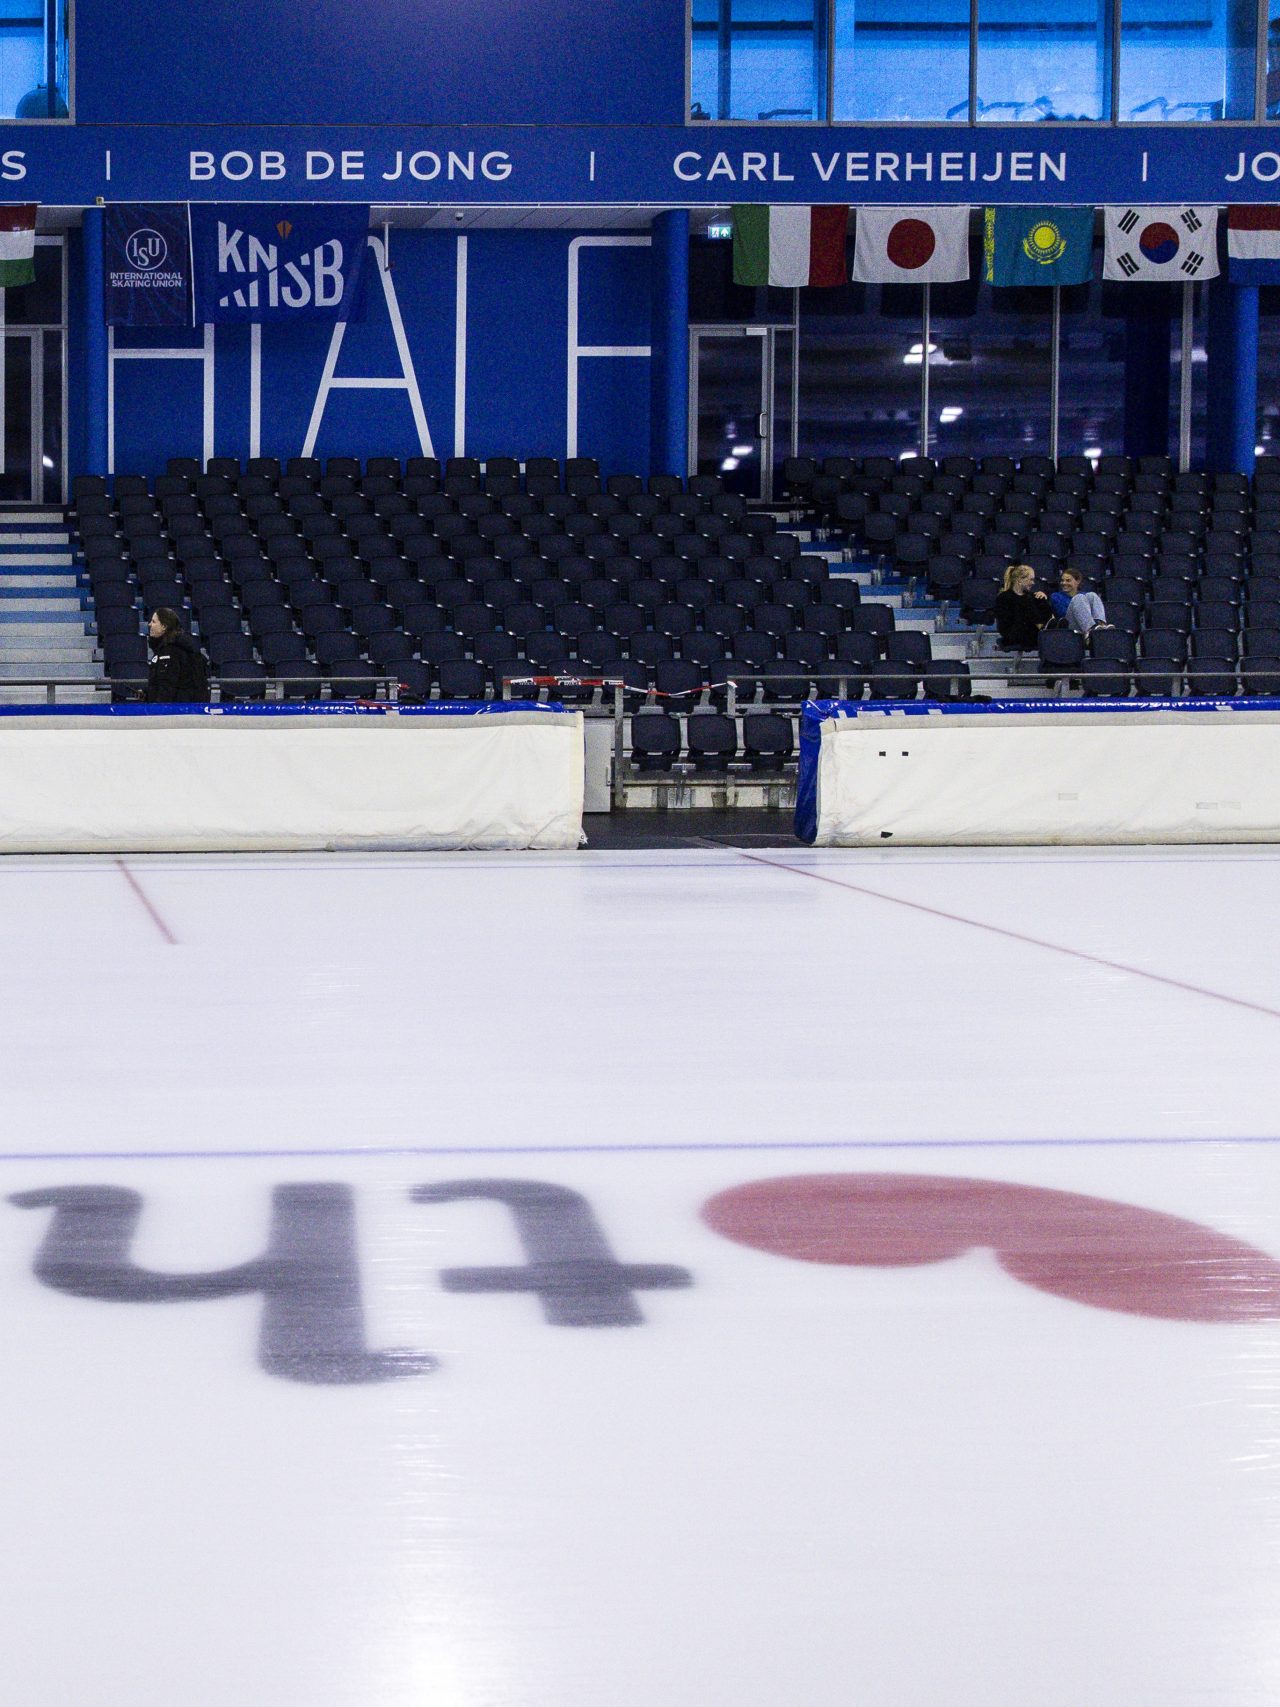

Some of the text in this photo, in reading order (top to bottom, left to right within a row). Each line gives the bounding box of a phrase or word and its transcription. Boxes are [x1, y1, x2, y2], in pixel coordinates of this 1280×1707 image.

[189, 150, 513, 182] BOB DE JONG
[673, 151, 1066, 182] CARL VERHEIJEN
[1224, 151, 1280, 182] JO
[131, 237, 161, 267] ISU
[109, 271, 184, 281] INTERNATIONAL
[111, 279, 183, 288] SKATING UNION
